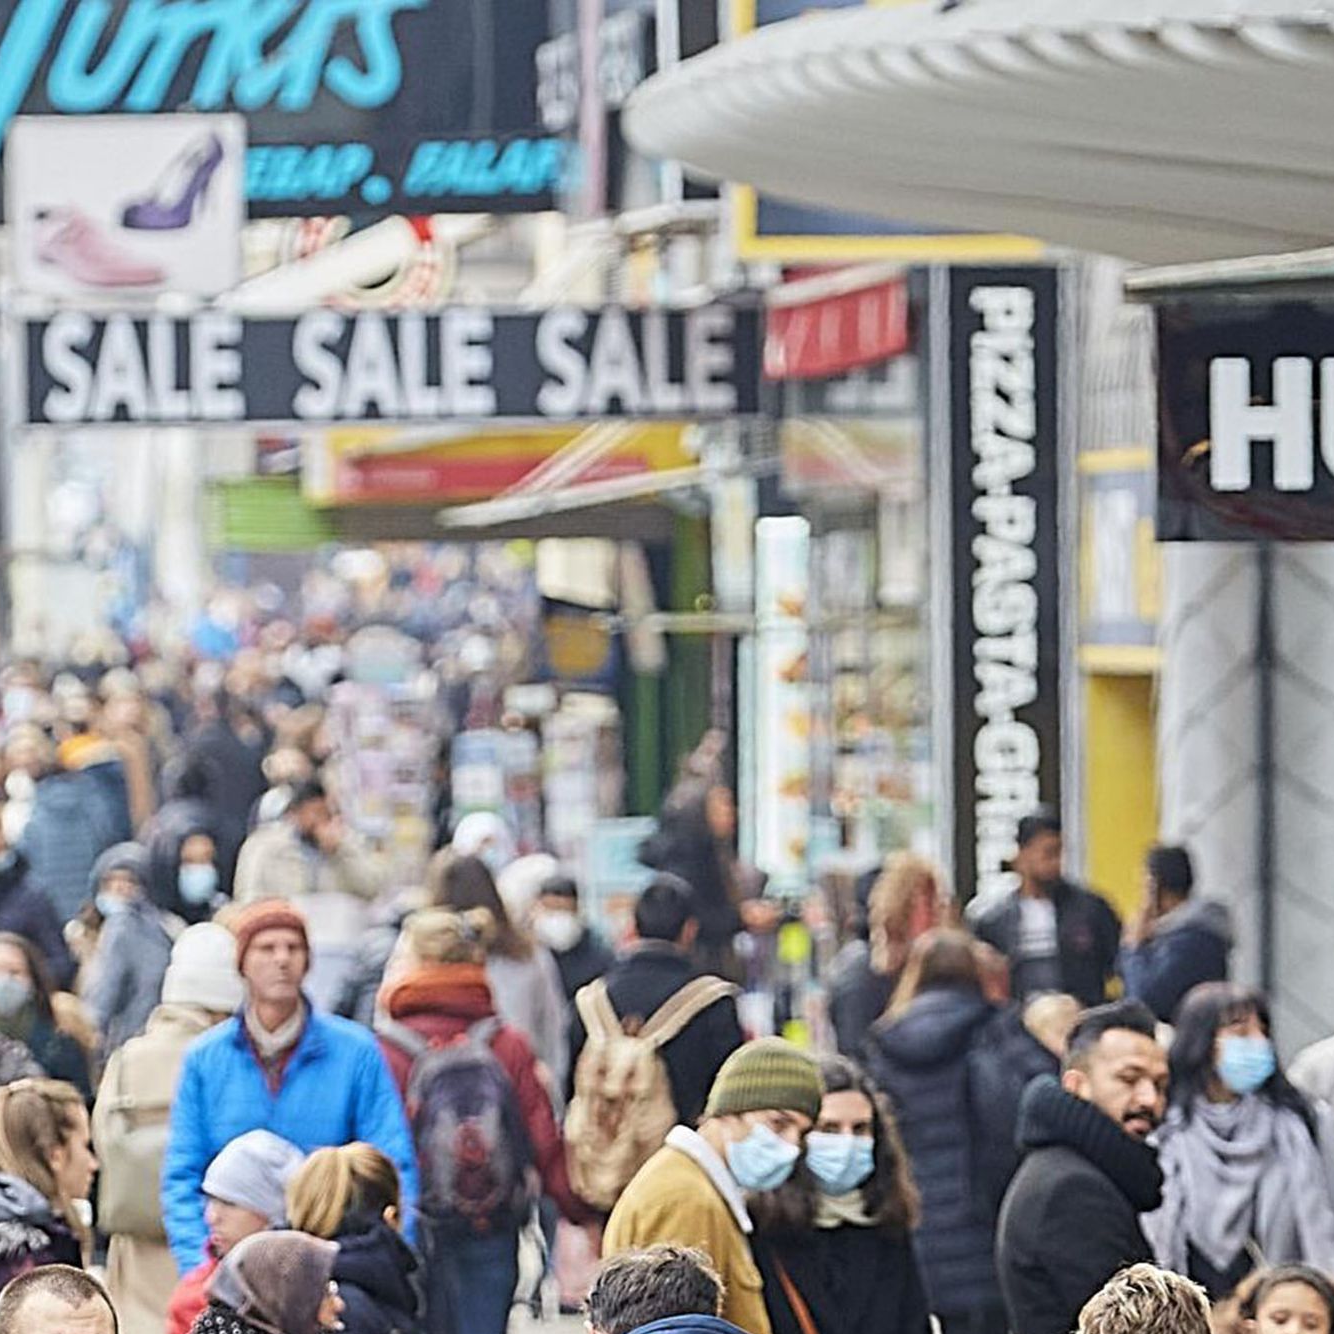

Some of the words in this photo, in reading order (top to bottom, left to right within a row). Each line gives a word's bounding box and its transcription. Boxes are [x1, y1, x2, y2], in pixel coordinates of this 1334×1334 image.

[41, 313, 242, 420] SALE
[292, 308, 497, 419] SALE
[535, 304, 737, 418] SALE
